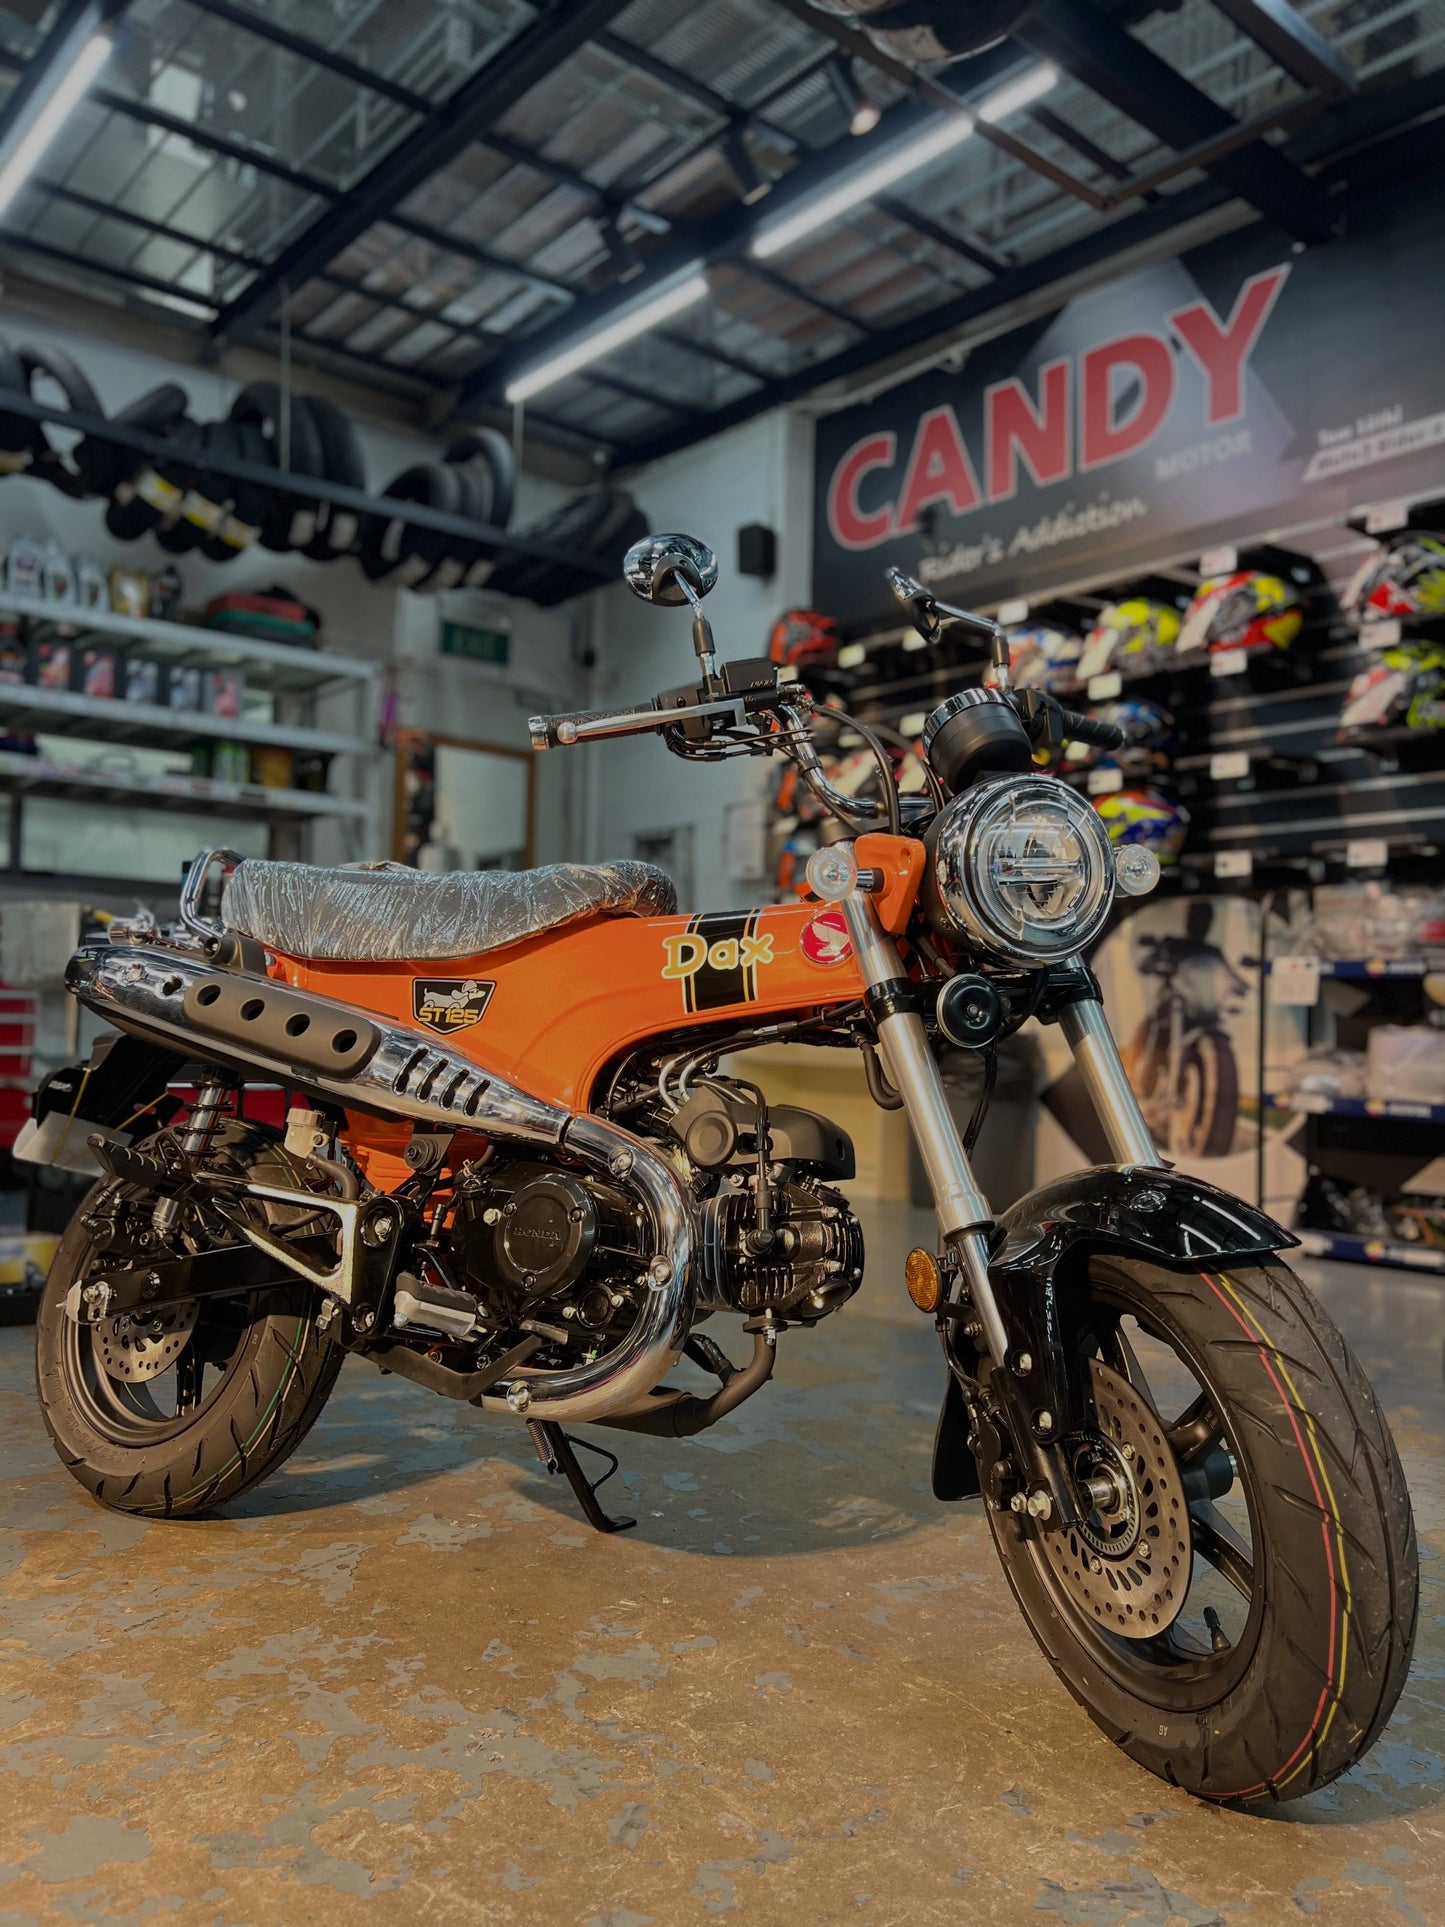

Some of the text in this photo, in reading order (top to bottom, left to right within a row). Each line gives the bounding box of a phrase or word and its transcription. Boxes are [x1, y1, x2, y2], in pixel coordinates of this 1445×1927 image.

[829, 264, 1291, 549] CANDY
[1155, 430, 1254, 482] MOTOR
[918, 491, 1148, 584] Rider's Addiction
[661, 932, 775, 980] Dax
[418, 1007, 479, 1025] ST125
[513, 1226, 561, 1242] HONDA
